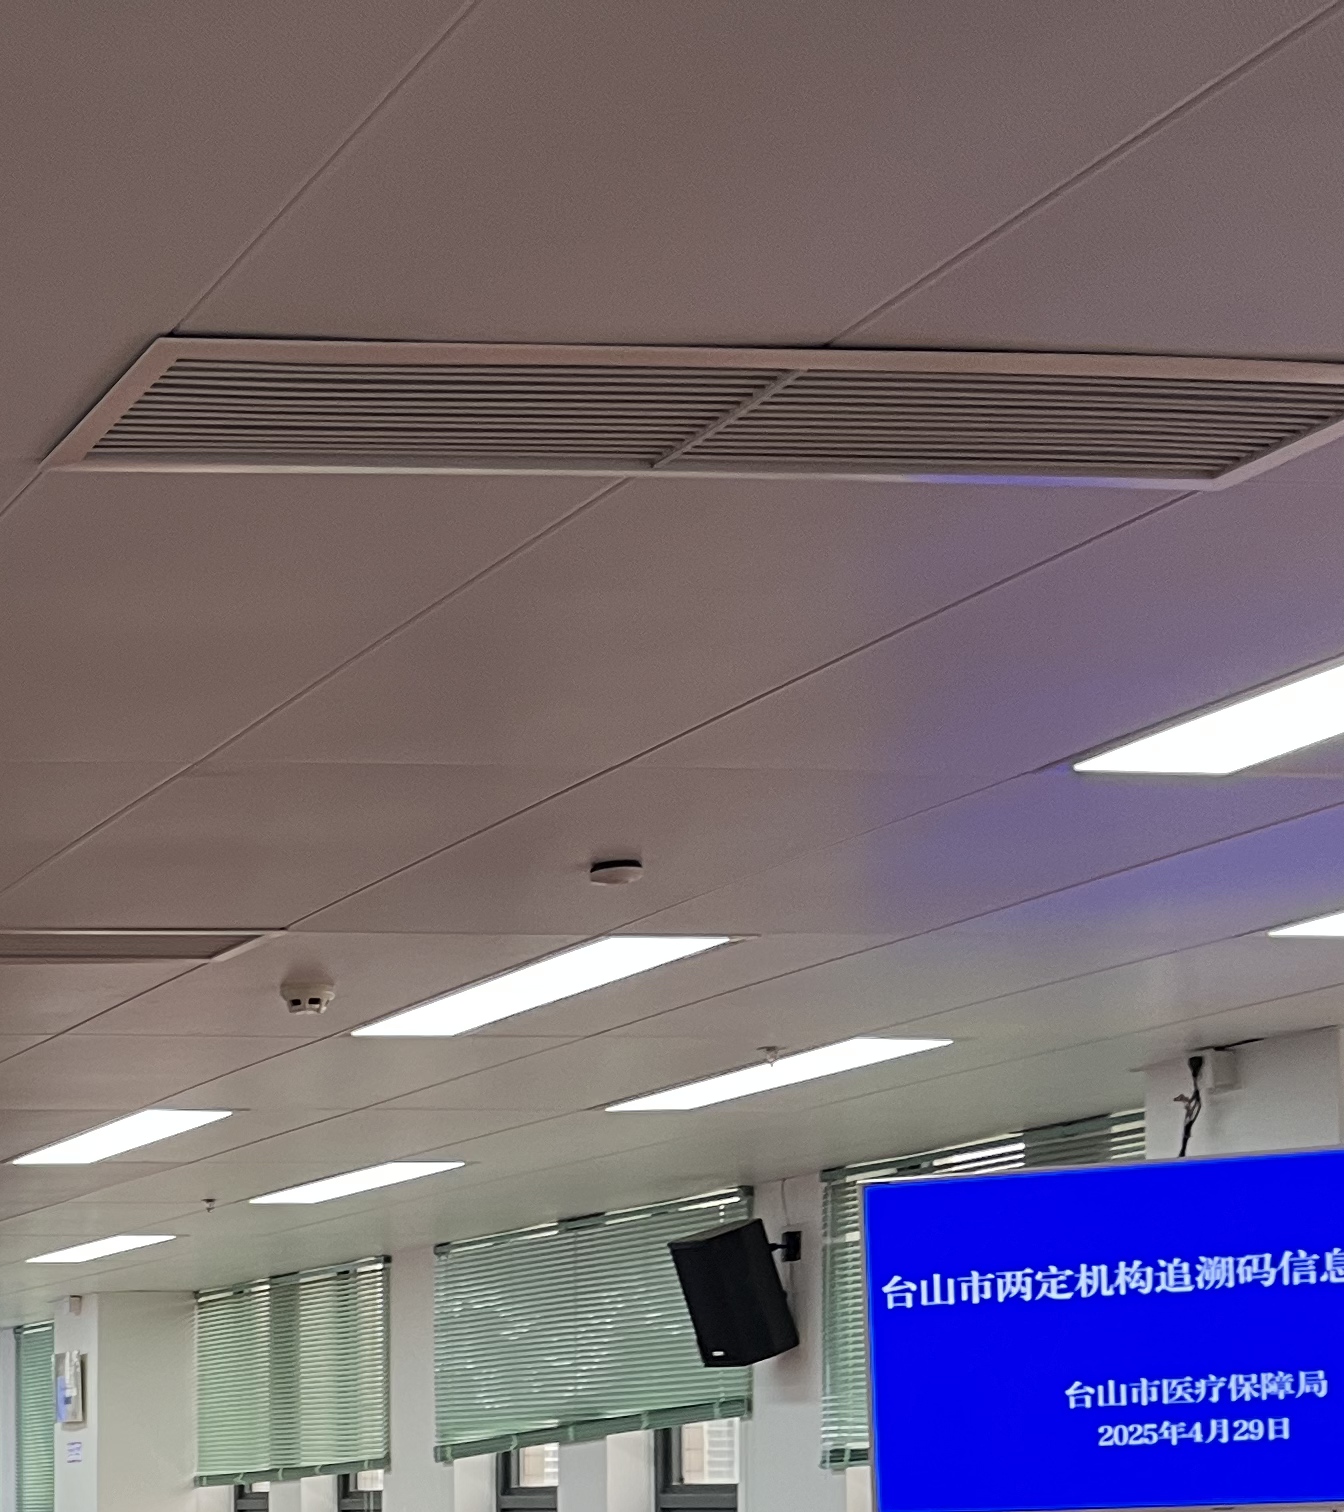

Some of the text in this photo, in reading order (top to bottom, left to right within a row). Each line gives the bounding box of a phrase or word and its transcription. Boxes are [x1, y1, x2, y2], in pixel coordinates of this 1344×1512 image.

[882, 1248, 1344, 1309] 台山市两定机构追溯码信息
[1065, 1370, 1328, 1409] 台山市医疗保障局
[1097, 1417, 1291, 1446] 2025年4月29日
